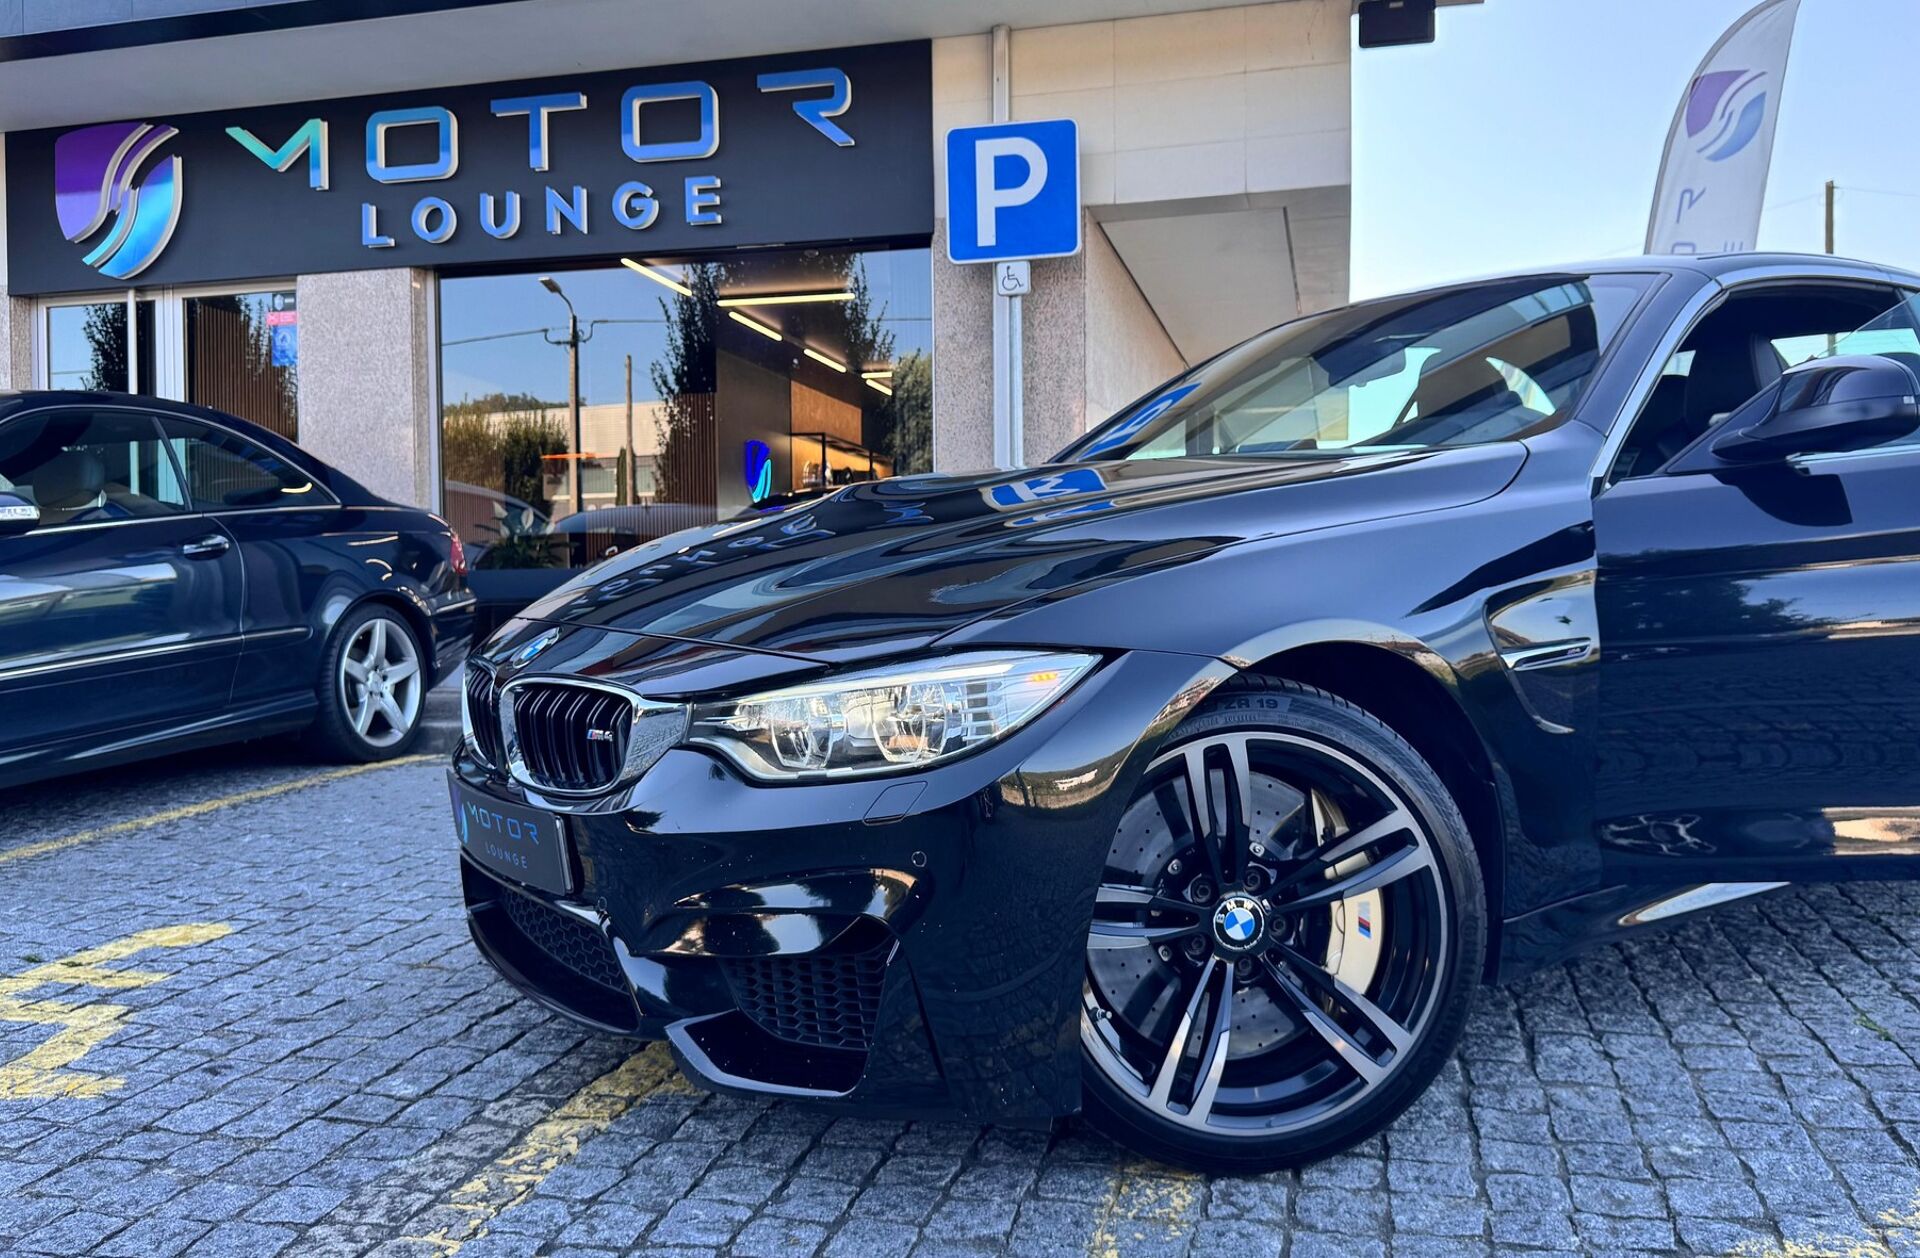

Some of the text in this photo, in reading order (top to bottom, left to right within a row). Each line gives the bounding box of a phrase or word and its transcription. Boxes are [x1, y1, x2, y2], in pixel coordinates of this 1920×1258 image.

[225, 67, 855, 191] MOTOR
[361, 175, 723, 248] LOUNGE
[975, 136, 1049, 247] P
[1256, 698, 1279, 710] 19
[466, 801, 540, 846] MOTOR
[484, 841, 528, 869] LOUNGE
